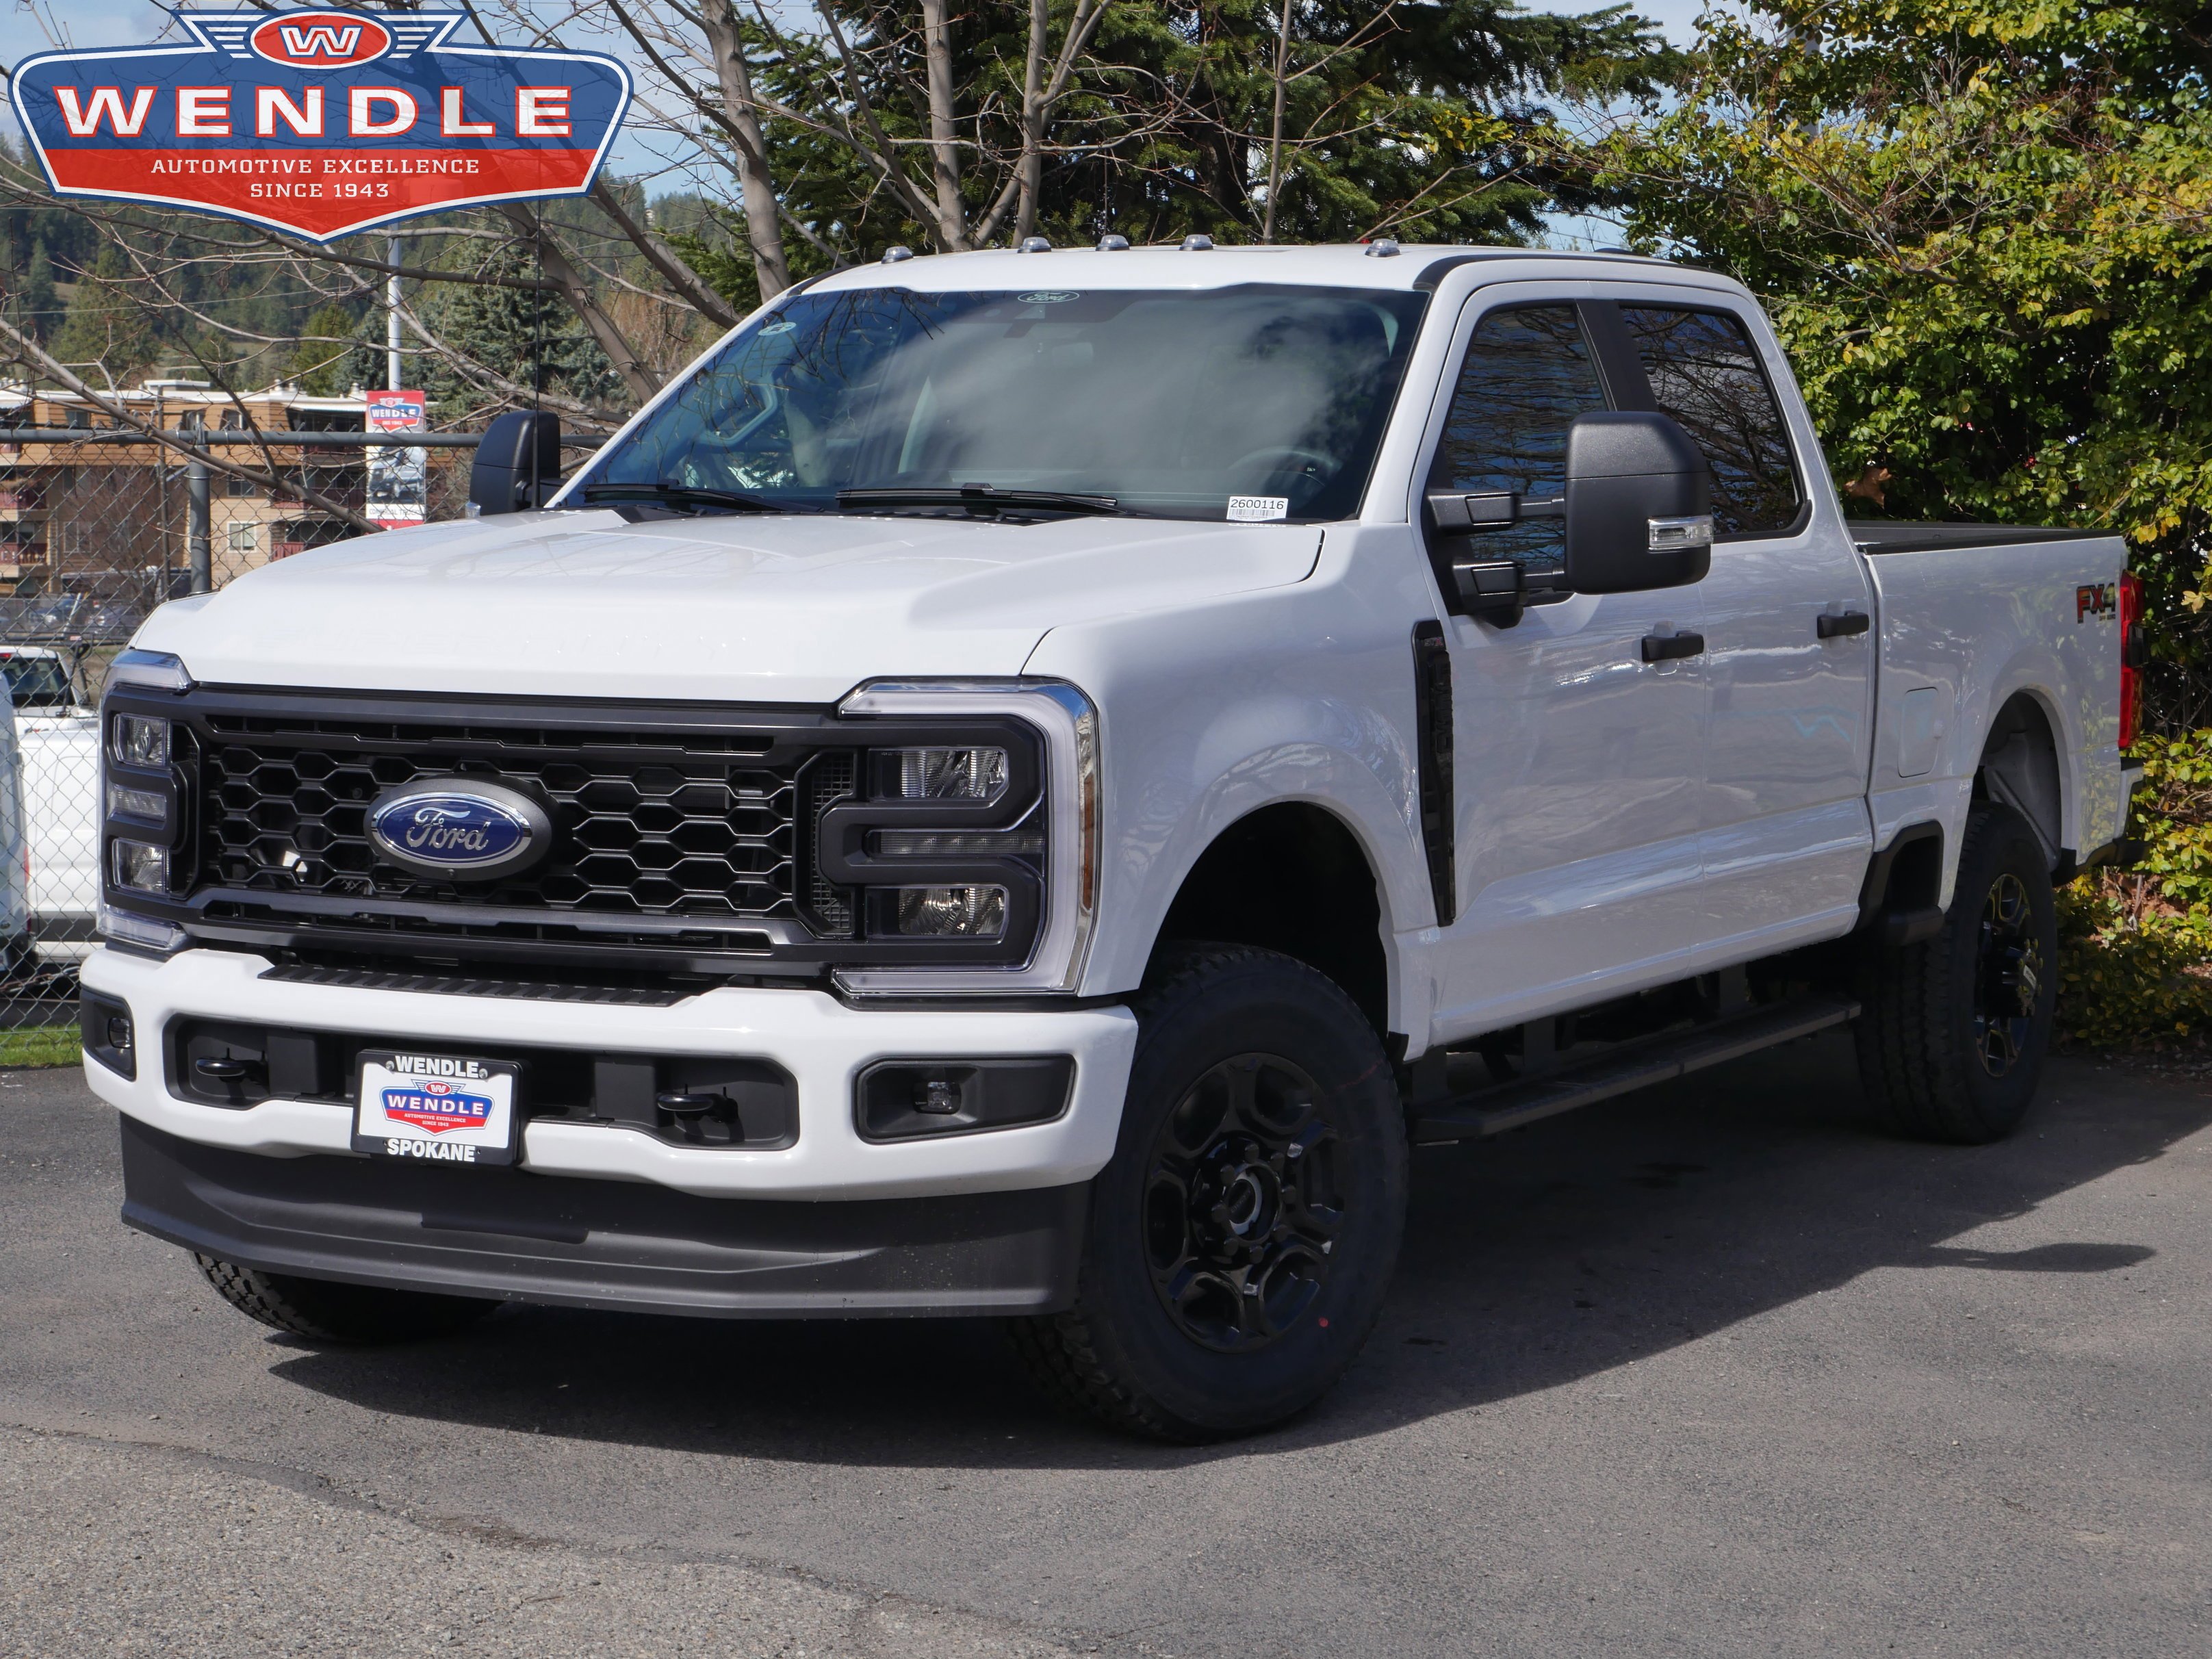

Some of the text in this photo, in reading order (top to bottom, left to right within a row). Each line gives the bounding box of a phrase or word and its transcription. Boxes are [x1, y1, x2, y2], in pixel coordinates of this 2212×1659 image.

[1027, 292, 1070, 301] Ford
[372, 408, 416, 418] WENDLE
[1231, 499, 1285, 510] 2600116
[2076, 582, 2116, 624] FX4
[1424, 636, 1444, 647] STX
[406, 807, 491, 850] Ford
[395, 1055, 479, 1079] WENDLE
[387, 1094, 484, 1116] WENDLE
[387, 1138, 476, 1162] SPOKANE
